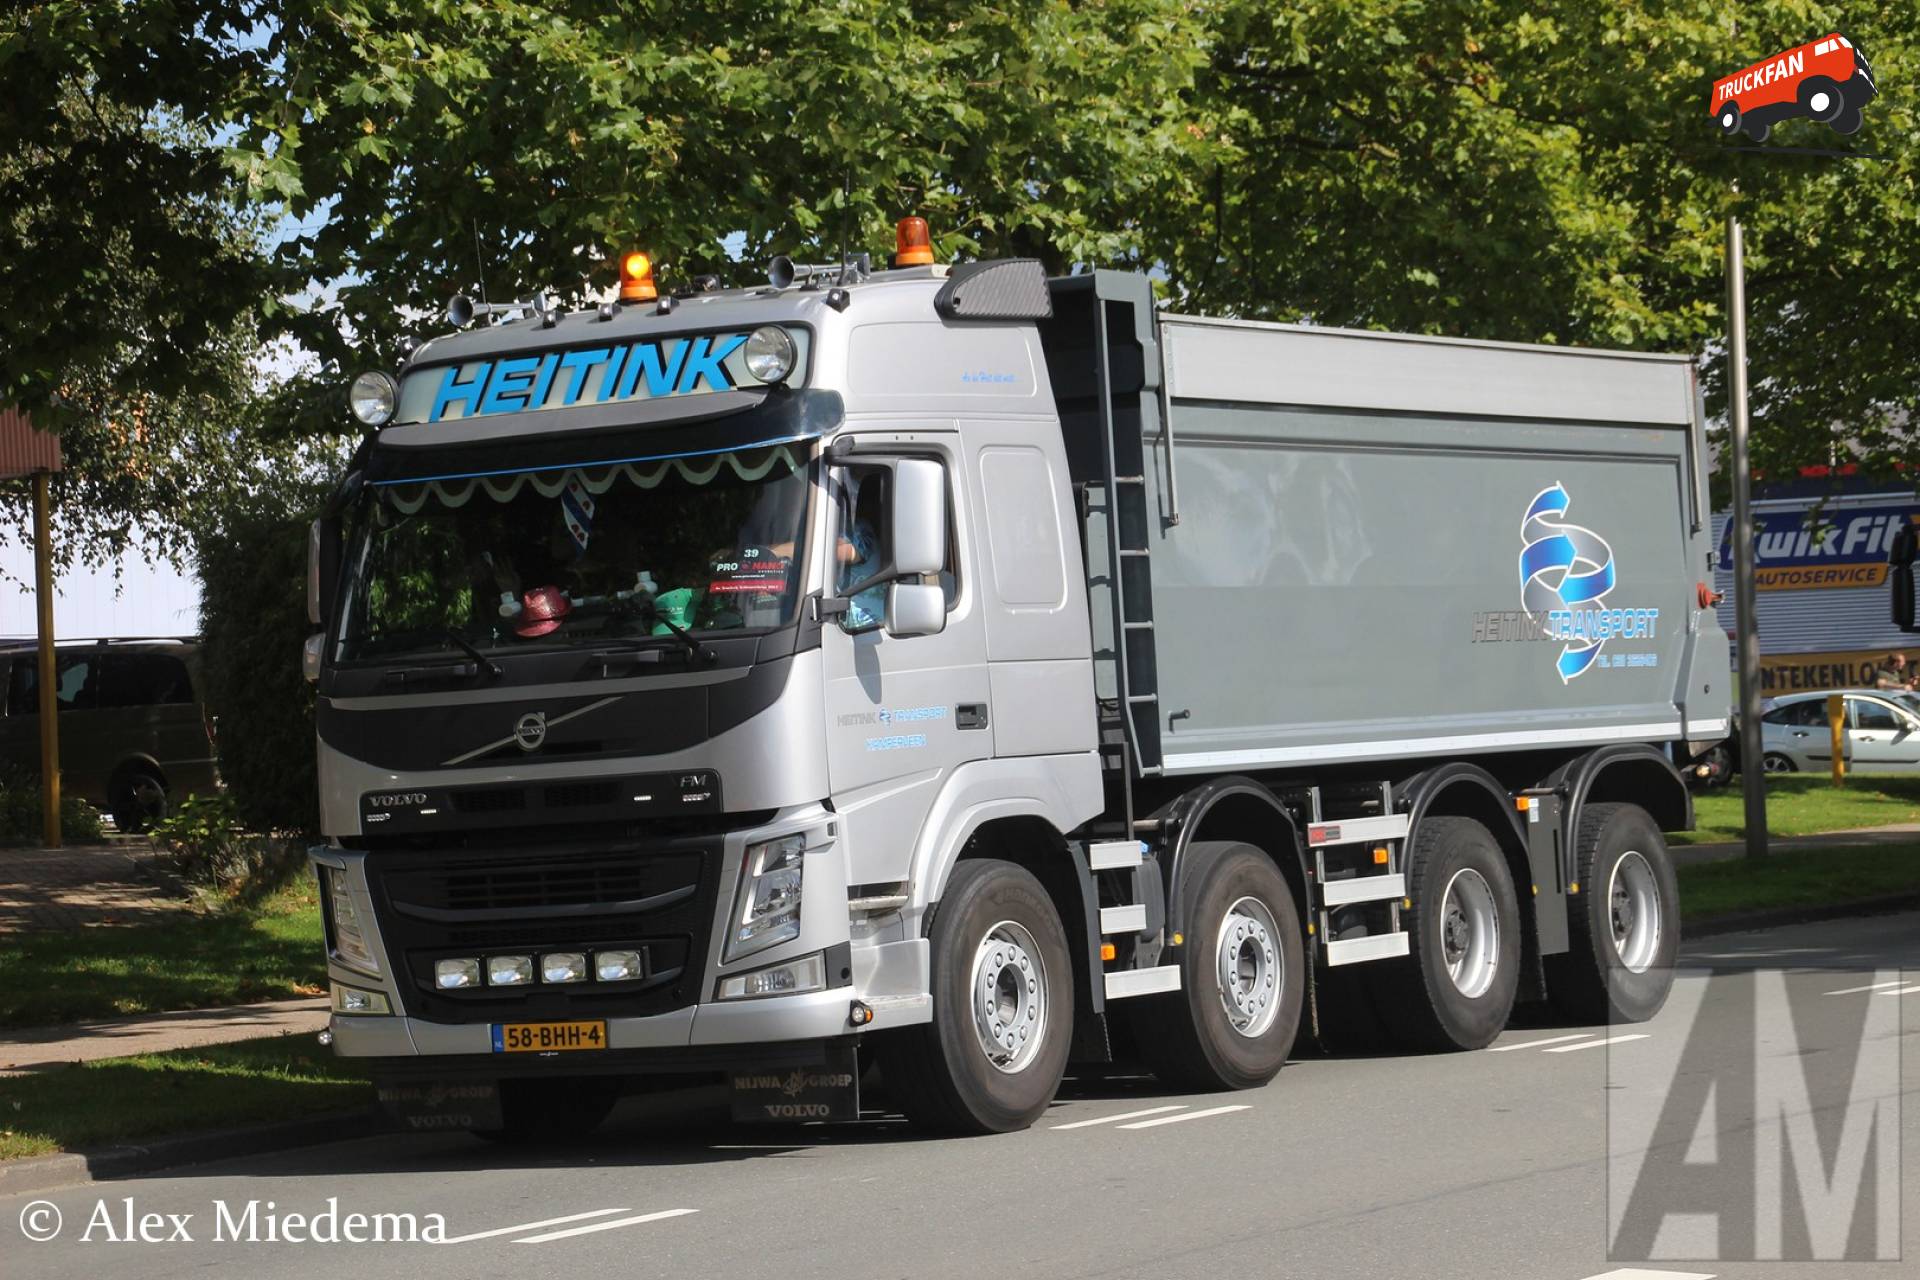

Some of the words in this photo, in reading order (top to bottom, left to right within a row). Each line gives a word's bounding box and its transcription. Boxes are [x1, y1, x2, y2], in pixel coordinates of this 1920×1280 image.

[429, 334, 749, 423] HEITINK
[743, 548, 759, 558] 39
[716, 562, 739, 572] PRO
[1756, 567, 1878, 586] AUTOSERVICE
[1472, 610, 1549, 643] HEITINK
[1549, 608, 1659, 641] TRANSPORT
[680, 774, 707, 788] FM
[369, 793, 427, 807] VOLVO
[508, 1024, 601, 1048] 58-BHH-4
[765, 1104, 830, 1117] VOLVO
